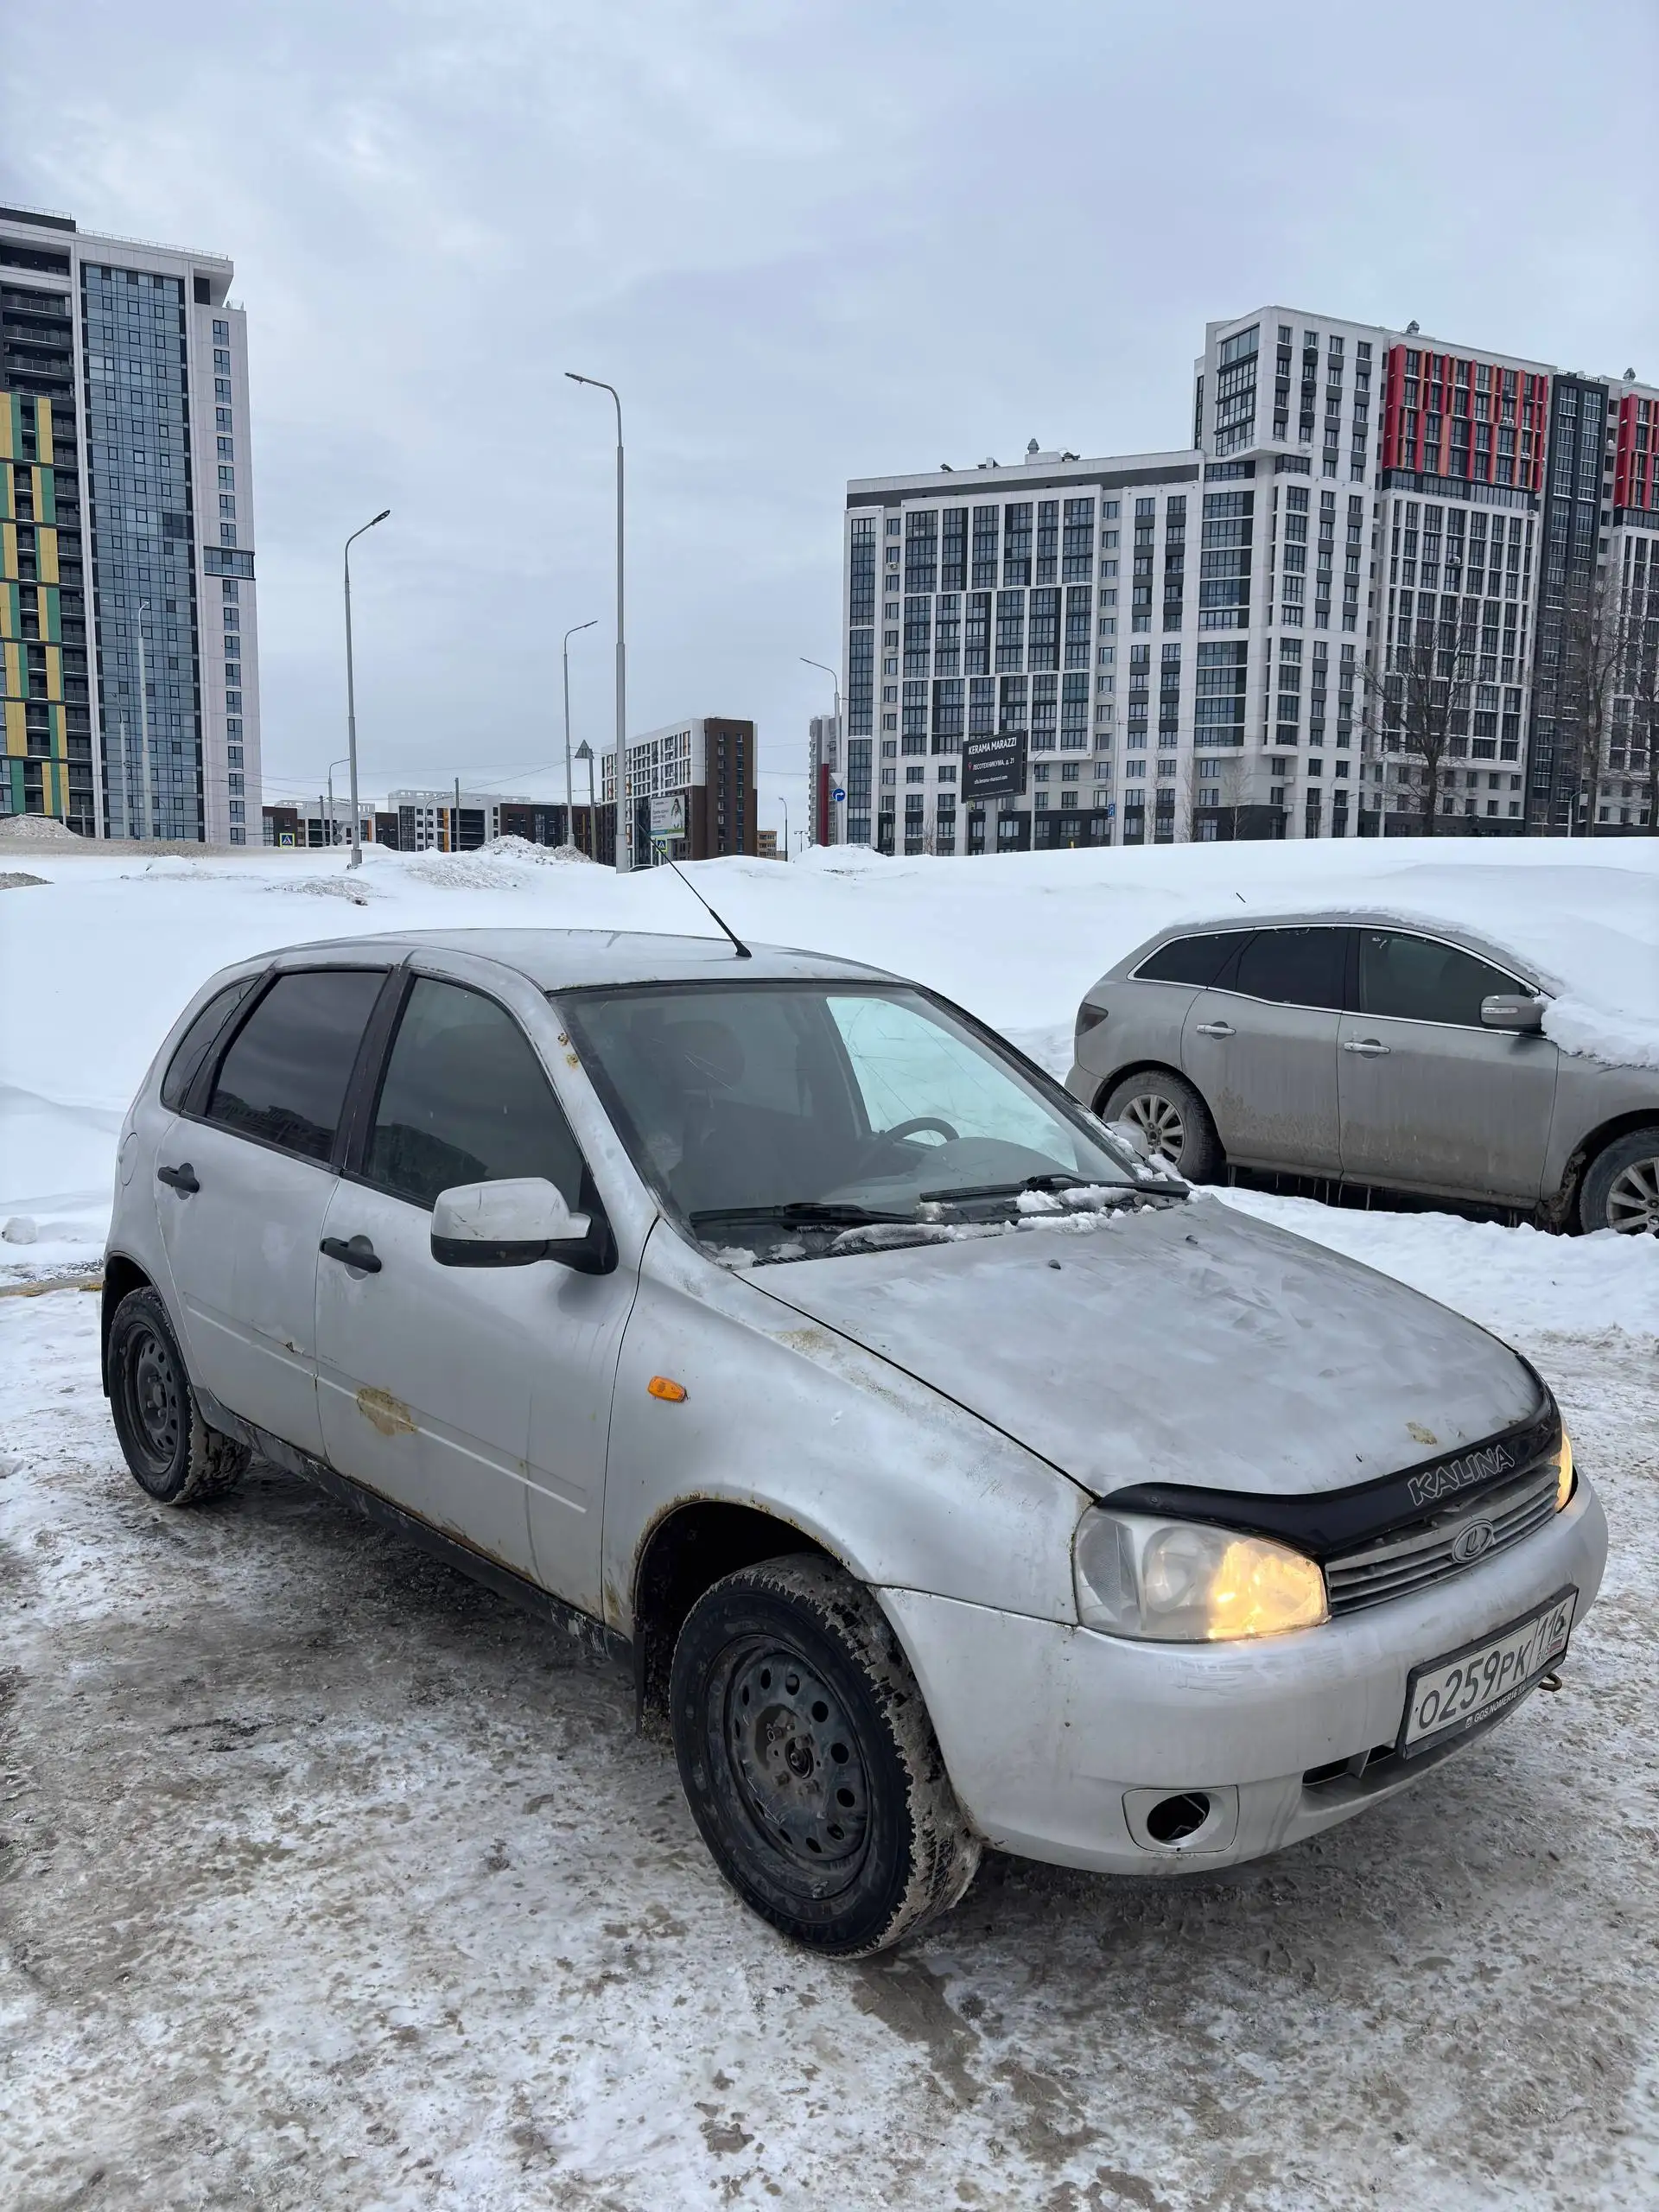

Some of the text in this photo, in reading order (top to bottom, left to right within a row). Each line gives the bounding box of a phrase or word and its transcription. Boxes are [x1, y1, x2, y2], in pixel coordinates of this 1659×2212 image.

[968, 737, 1017, 755] KERAMA MARAZZI
[1407, 1444, 1516, 1506] KALINA
